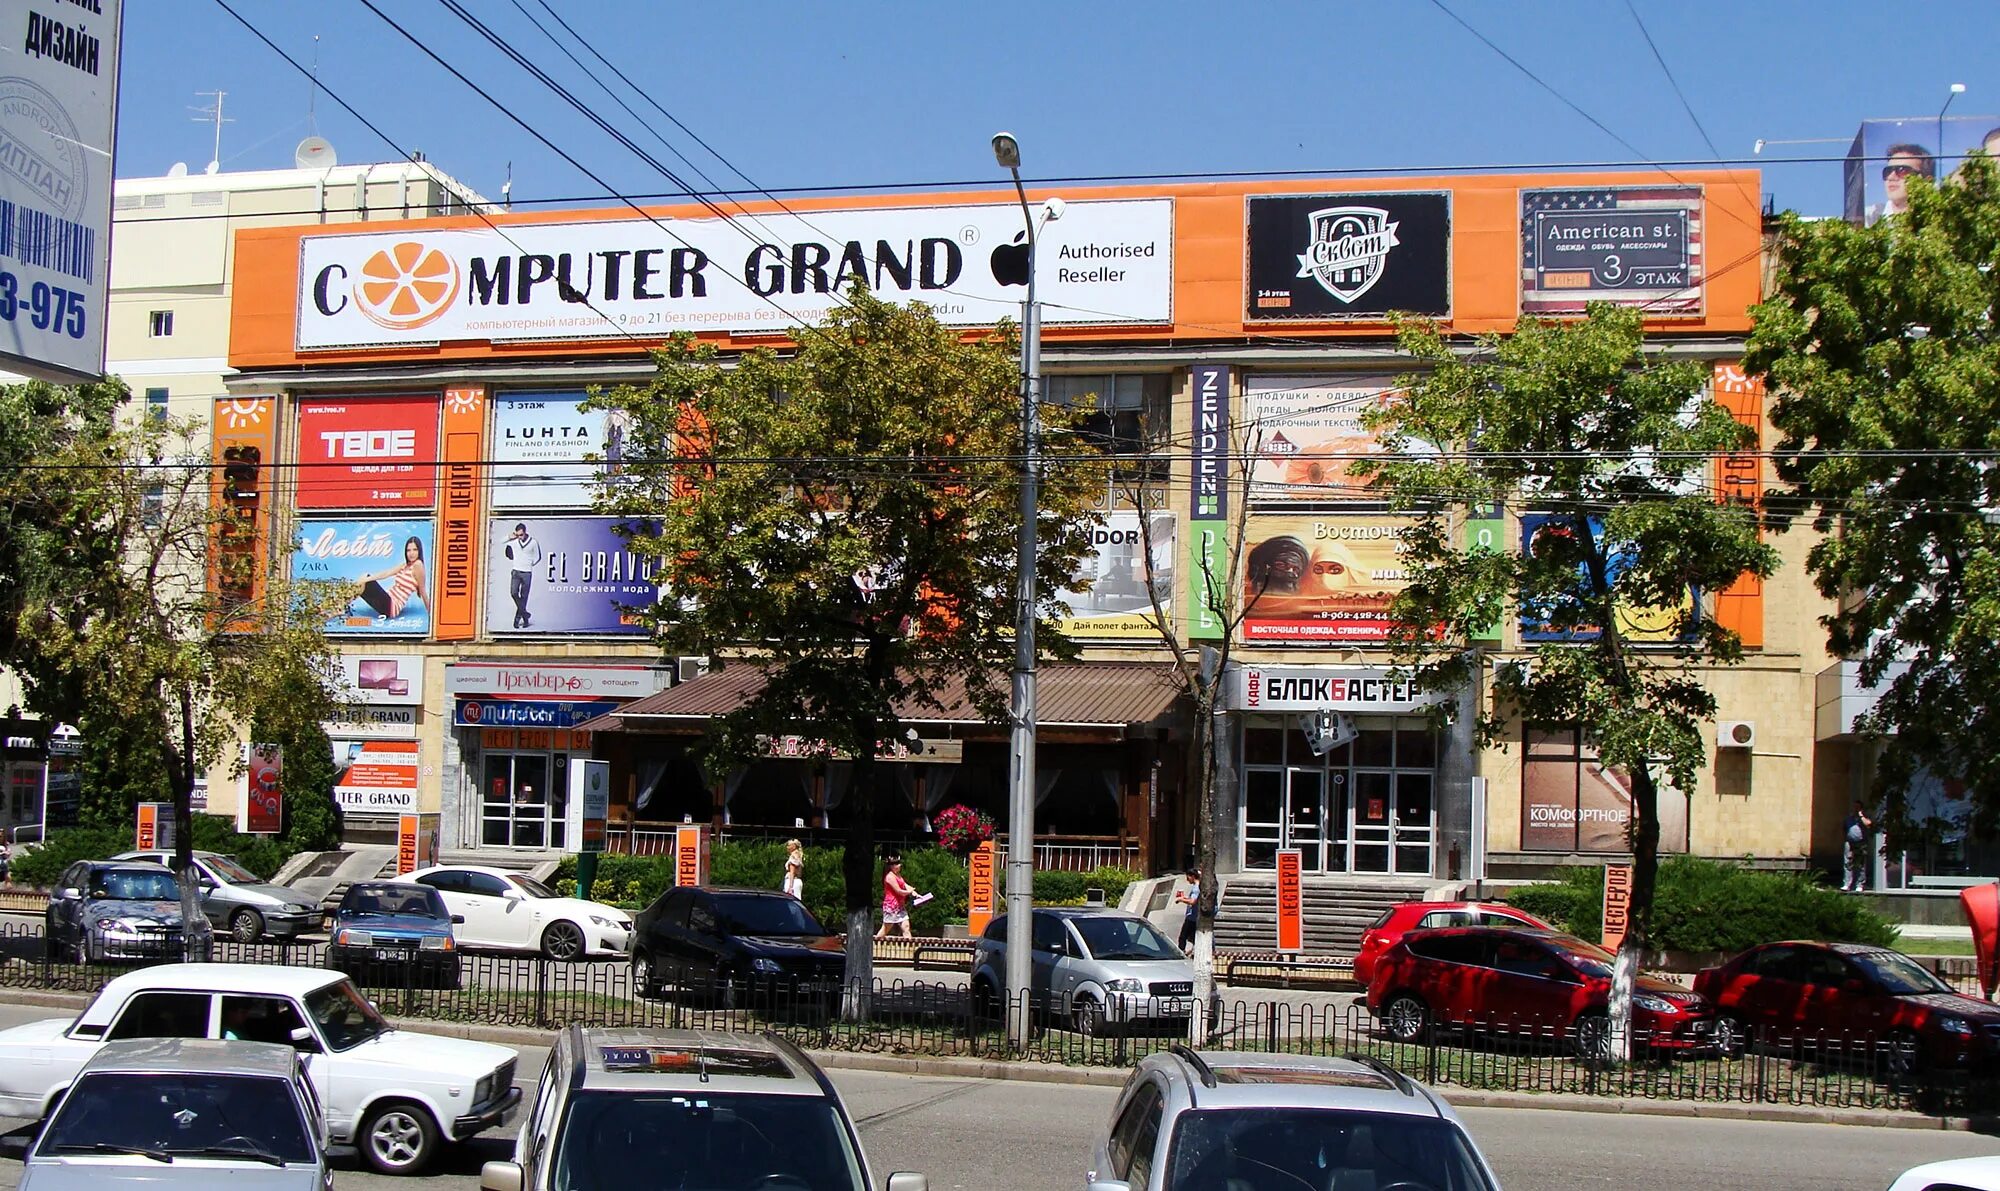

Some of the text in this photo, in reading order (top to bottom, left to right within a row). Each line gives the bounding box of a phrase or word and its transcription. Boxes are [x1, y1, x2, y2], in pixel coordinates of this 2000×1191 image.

[25, 10, 99, 76] ДИЗАЙН
[1548, 223, 1678, 240] American st.
[1059, 242, 1155, 259] Authorised
[1313, 236, 1386, 265] Сквот
[1620, 242, 1668, 250] АКСЕССУАРЫ
[744, 237, 963, 297] GRAND
[1058, 266, 1126, 283] Reseller
[1603, 254, 1682, 285] 3 ЭТАЖ
[466, 316, 556, 331] компьютерный
[558, 316, 607, 328] магазин
[619, 313, 627, 325] 9
[629, 314, 645, 326] до
[648, 312, 661, 324] 21
[664, 310, 686, 322] без
[689, 311, 751, 325] перерыва
[754, 308, 776, 320] без
[1256, 392, 1309, 400] ПОДУШКИ
[507, 401, 545, 410] 3 этаж
[1256, 406, 1291, 414] ПЛЕДЫ
[505, 426, 589, 439] LUHTA
[1200, 371, 1218, 495] ZENDEN
[320, 429, 416, 458] ТВОЕ
[372, 490, 379, 499] 2
[380, 491, 403, 499] этаж
[301, 562, 329, 571] ZARA
[446, 519, 470, 598] ТОРГОВЫЙ
[547, 551, 651, 582] EL BRAVO
[548, 585, 650, 594] молодежная мода
[374, 614, 387, 627] 3
[1321, 611, 1388, 621] 8-962-428-44
[1073, 622, 1091, 630] Дай
[1093, 622, 1119, 630] полет
[1251, 625, 1299, 634] ВОСТОЧНАЯ
[1300, 626, 1336, 635] ОДЕЖДА,
[1248, 671, 1260, 707] КАФЕ
[1266, 677, 1424, 703] БЛОКБАСТЕР
[371, 711, 410, 722] GRAND
[369, 793, 410, 805] GRAND
[1530, 807, 1627, 822] КОМФОРТНОЕ
[400, 833, 415, 874] СТЕРОВ
[681, 847, 696, 887] СТЕРОВ
[1605, 869, 1627, 935] НЕСТЕРОВ
